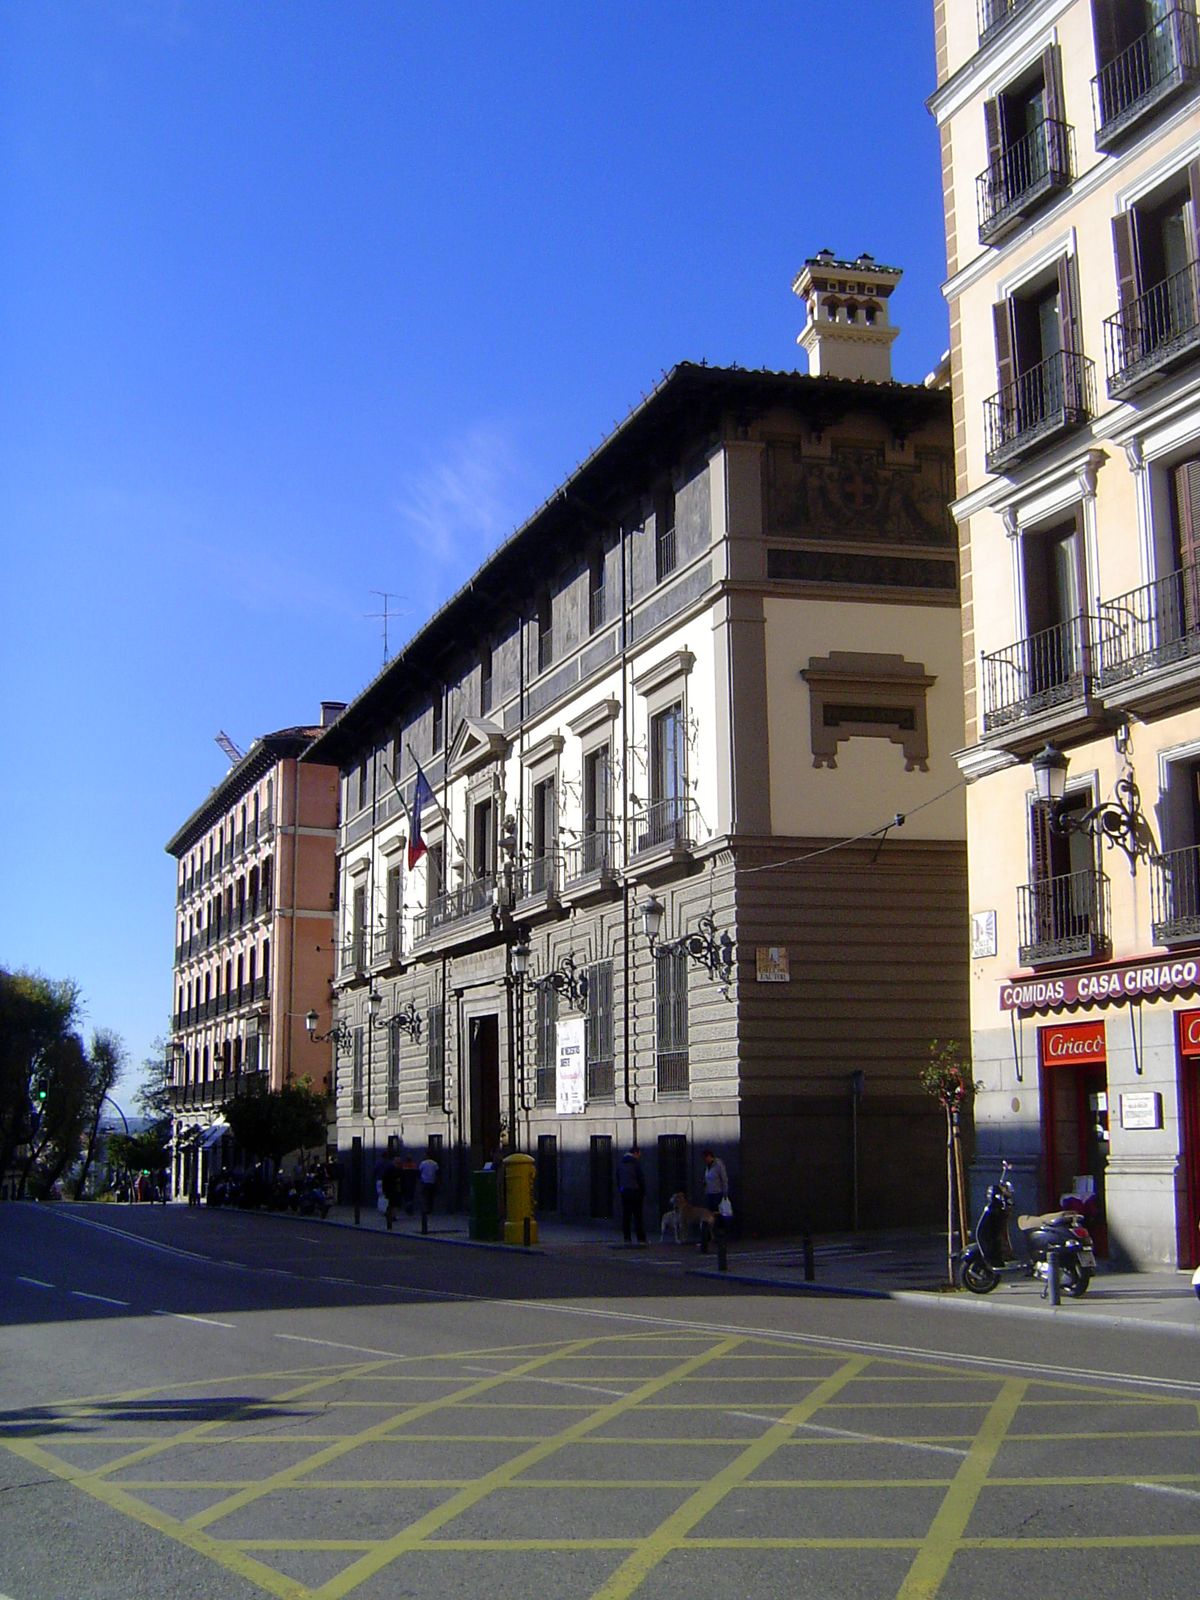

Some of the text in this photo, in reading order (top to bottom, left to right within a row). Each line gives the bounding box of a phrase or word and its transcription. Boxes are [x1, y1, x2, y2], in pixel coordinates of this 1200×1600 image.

[1003, 962, 1197, 1004] COMIDAS CASA CIRIACO
[1049, 1034, 1105, 1056] Ciriaco
